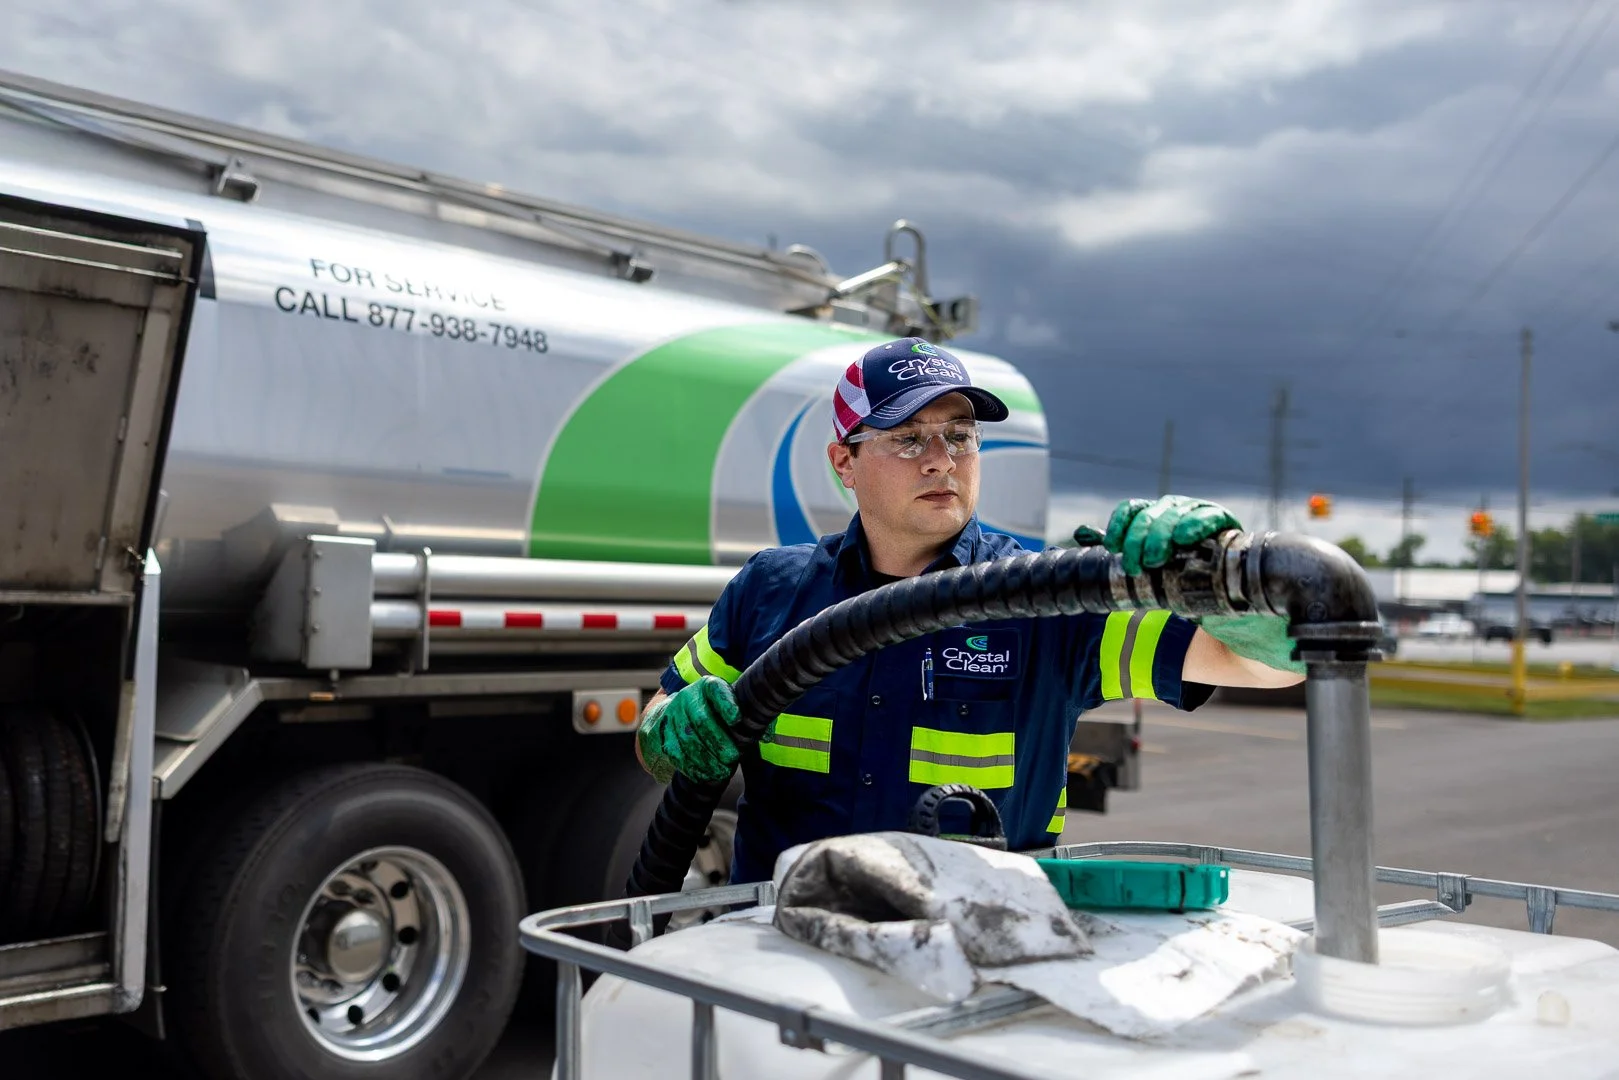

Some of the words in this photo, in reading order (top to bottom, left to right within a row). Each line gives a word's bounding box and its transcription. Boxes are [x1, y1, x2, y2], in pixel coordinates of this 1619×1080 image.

[310, 258, 375, 288] FOR
[275, 286, 358, 323] CALL
[367, 302, 549, 354] 877-938-7948
[888, 357, 962, 375] Crystal
[897, 366, 964, 382] Clean
[942, 647, 1010, 664] Crystal
[946, 658, 1004, 673] Clean
